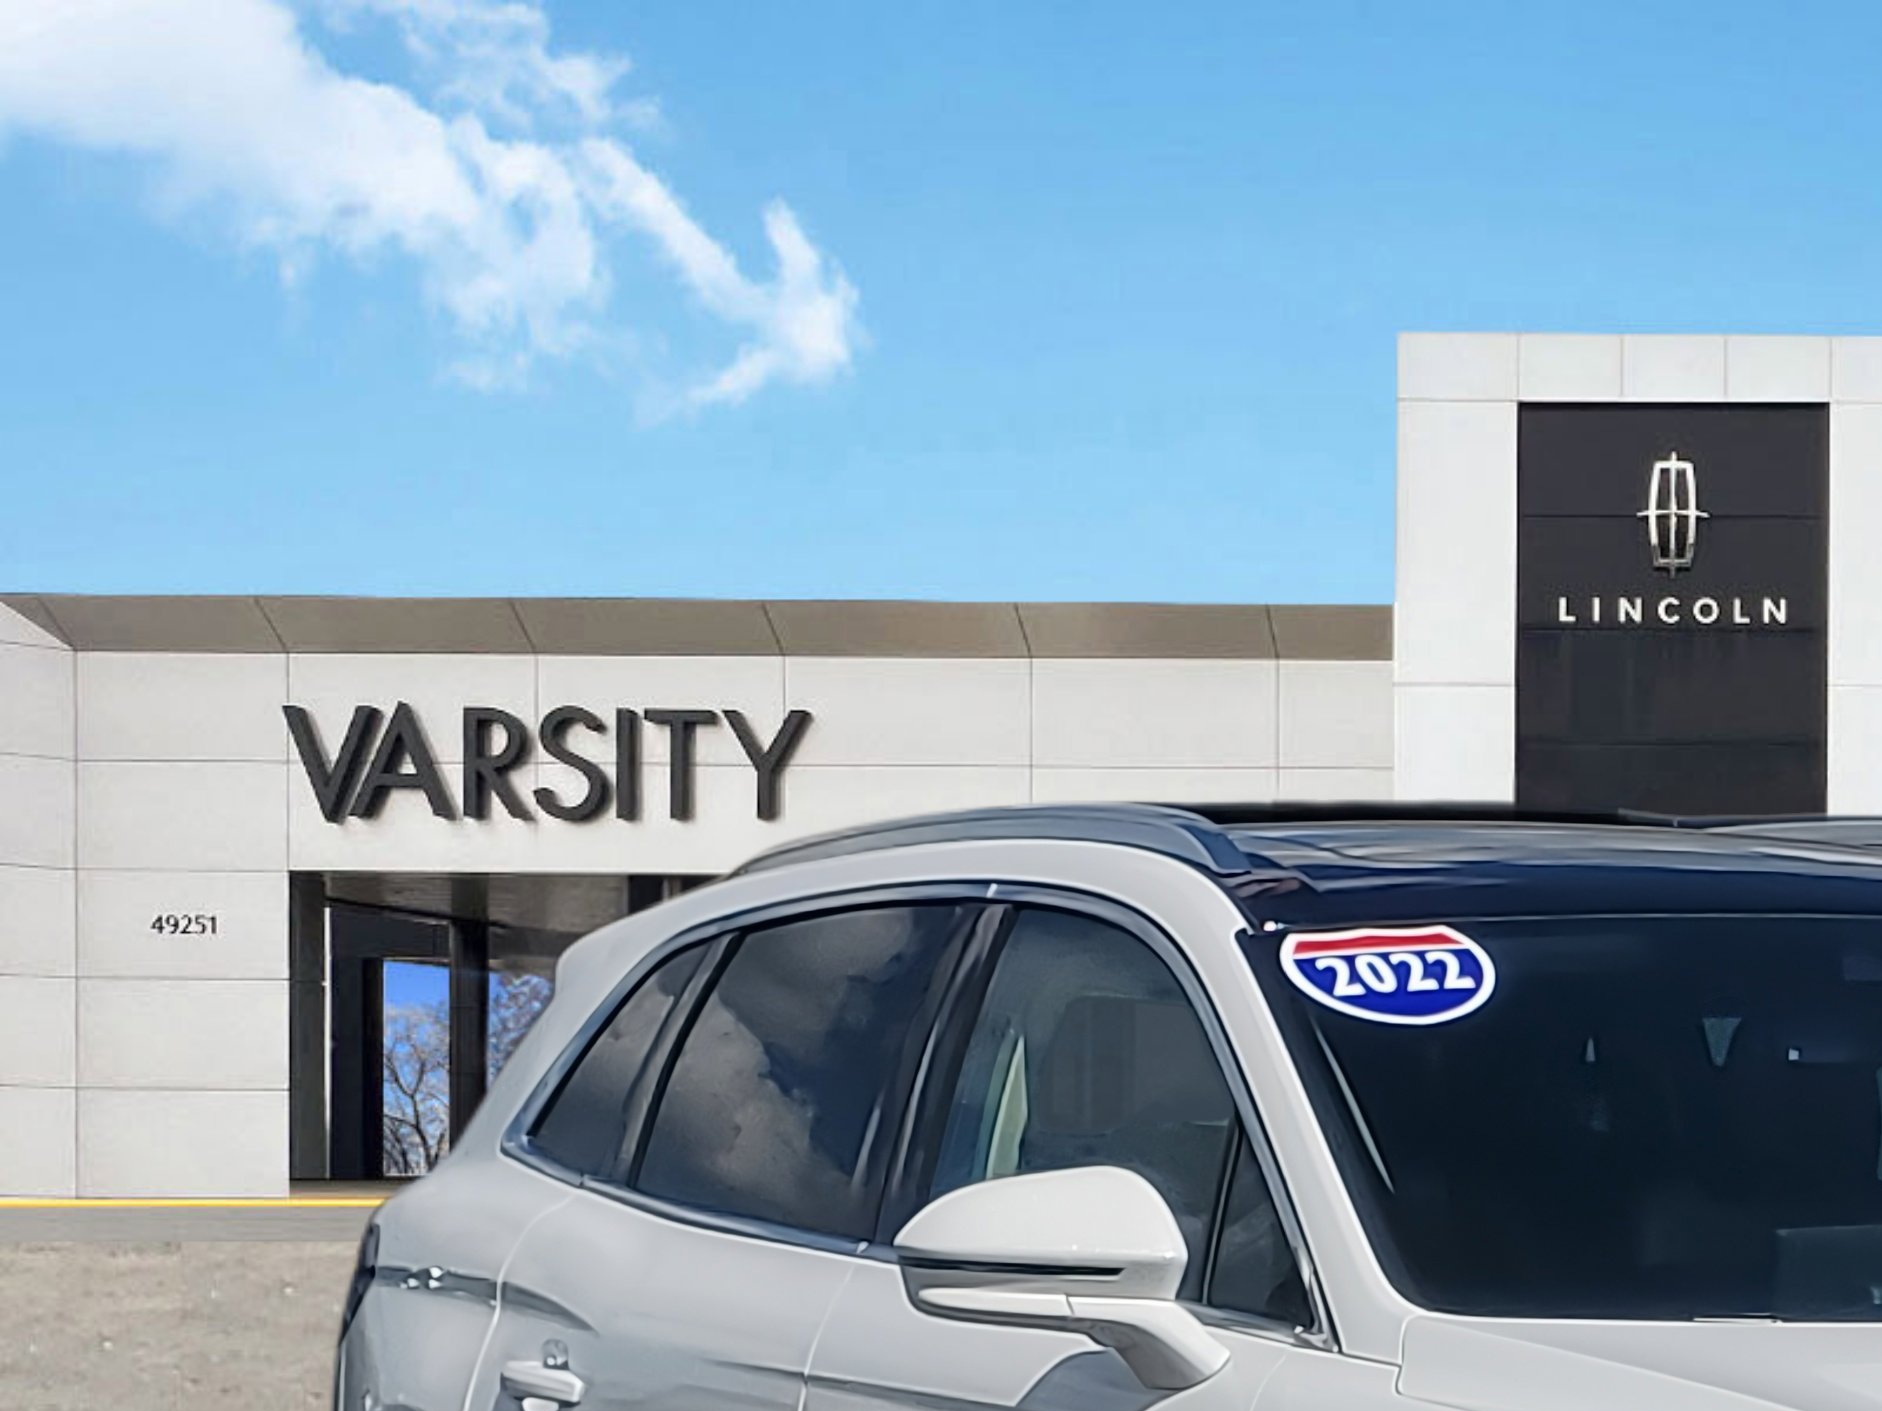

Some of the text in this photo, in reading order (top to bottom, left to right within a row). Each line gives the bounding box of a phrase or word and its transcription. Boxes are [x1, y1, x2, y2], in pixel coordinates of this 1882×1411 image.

[1558, 596, 1787, 624] LINCOLN
[282, 701, 813, 824] VARSITY
[150, 914, 216, 934] 49251
[1315, 951, 1476, 997] 2022
